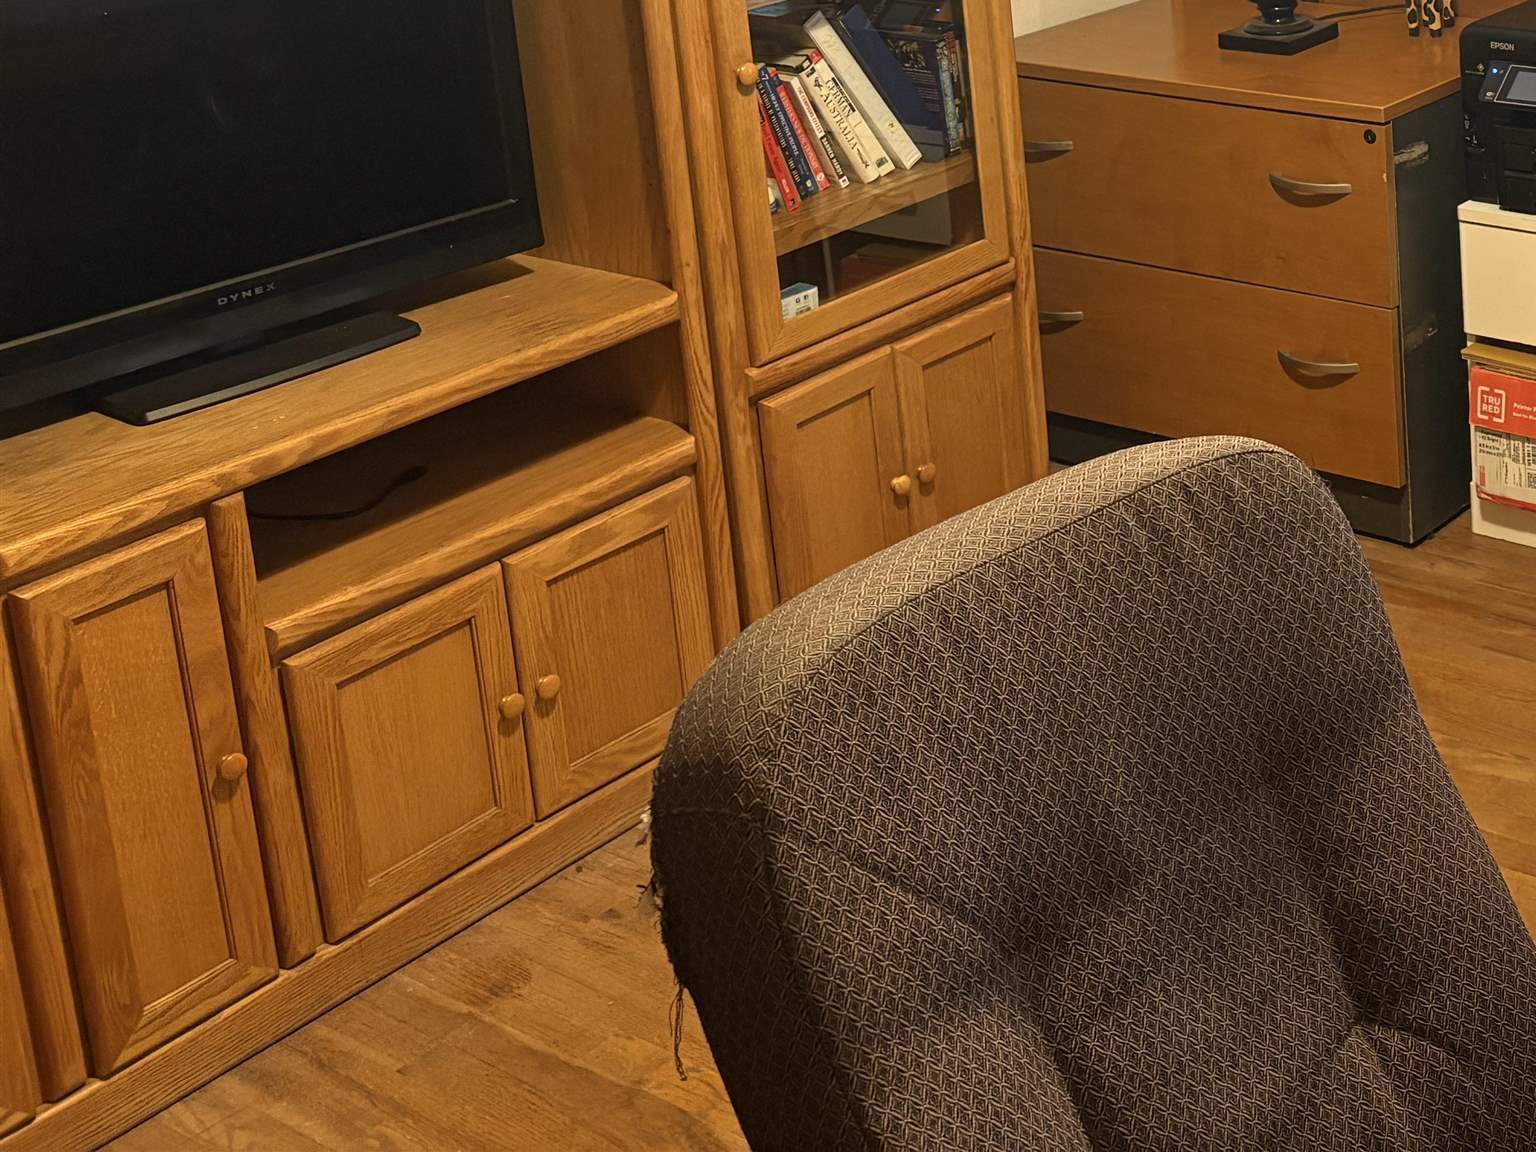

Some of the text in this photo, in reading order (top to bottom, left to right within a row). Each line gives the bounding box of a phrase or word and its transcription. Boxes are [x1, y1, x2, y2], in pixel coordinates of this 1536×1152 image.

[1490, 41, 1514, 51] EPSON
[825, 78, 852, 118] GERMAN
[820, 88, 858, 150] AUSTRALIA
[217, 282, 276, 306] DYNEX
[1482, 394, 1500, 406] TRU
[1482, 404, 1500, 414] RED
[1513, 402, 1532, 412] Printer
